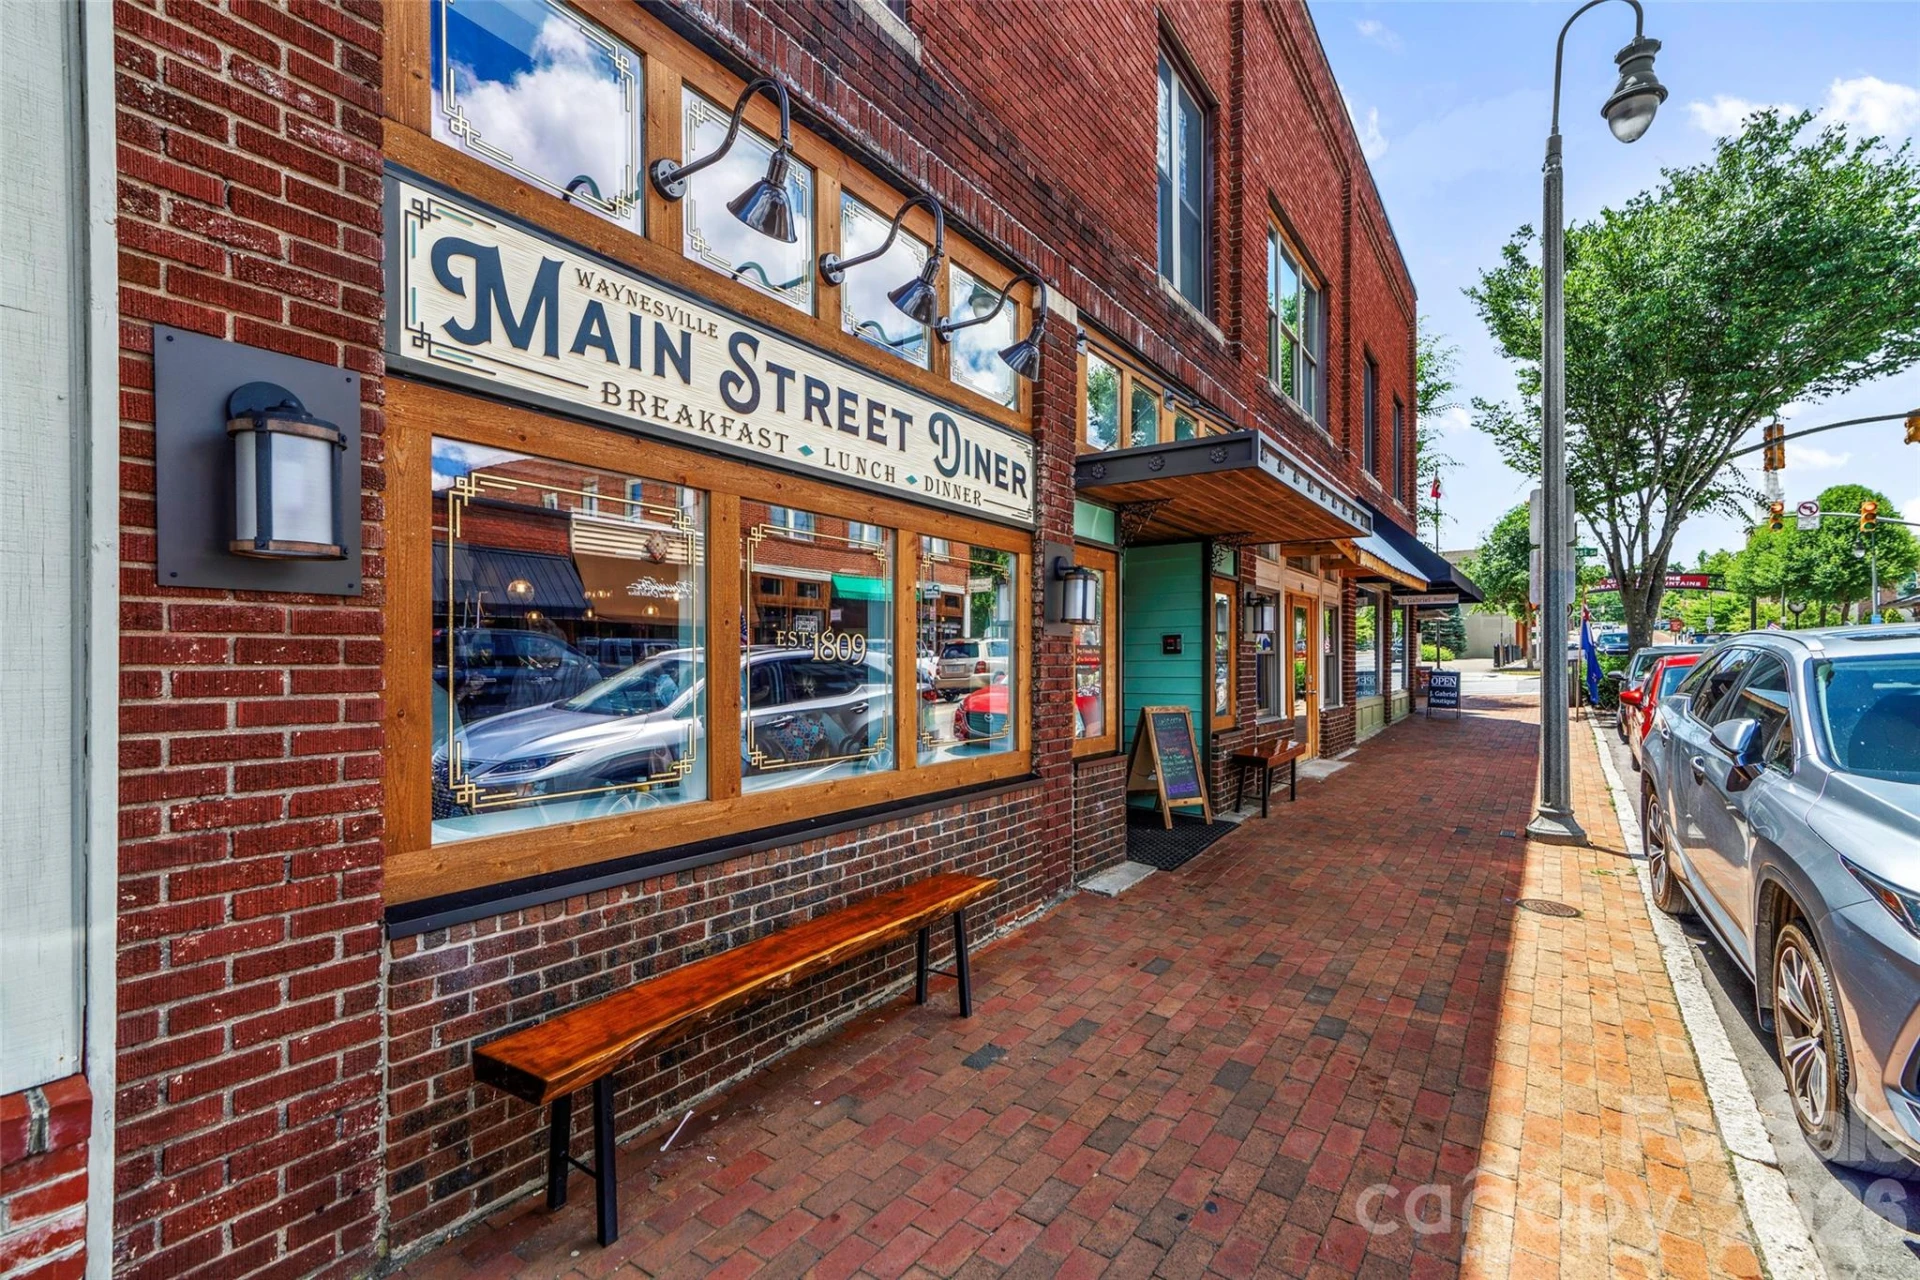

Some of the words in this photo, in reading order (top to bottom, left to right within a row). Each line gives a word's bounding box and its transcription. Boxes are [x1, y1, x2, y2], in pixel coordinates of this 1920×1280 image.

[574, 267, 719, 340] WAYNESVILLE
[431, 236, 692, 386] MAIN
[719, 331, 913, 453] STREET
[929, 411, 1029, 499] DINER
[600, 380, 790, 452] BREAKFAST
[823, 447, 897, 485] LUNCH
[923, 473, 983, 507] DINNER
[810, 626, 866, 666] 1809
[1430, 697, 1457, 706] Boutique
[1431, 675, 1457, 688] OPEN
[1434, 690, 1458, 698] Gabriel
